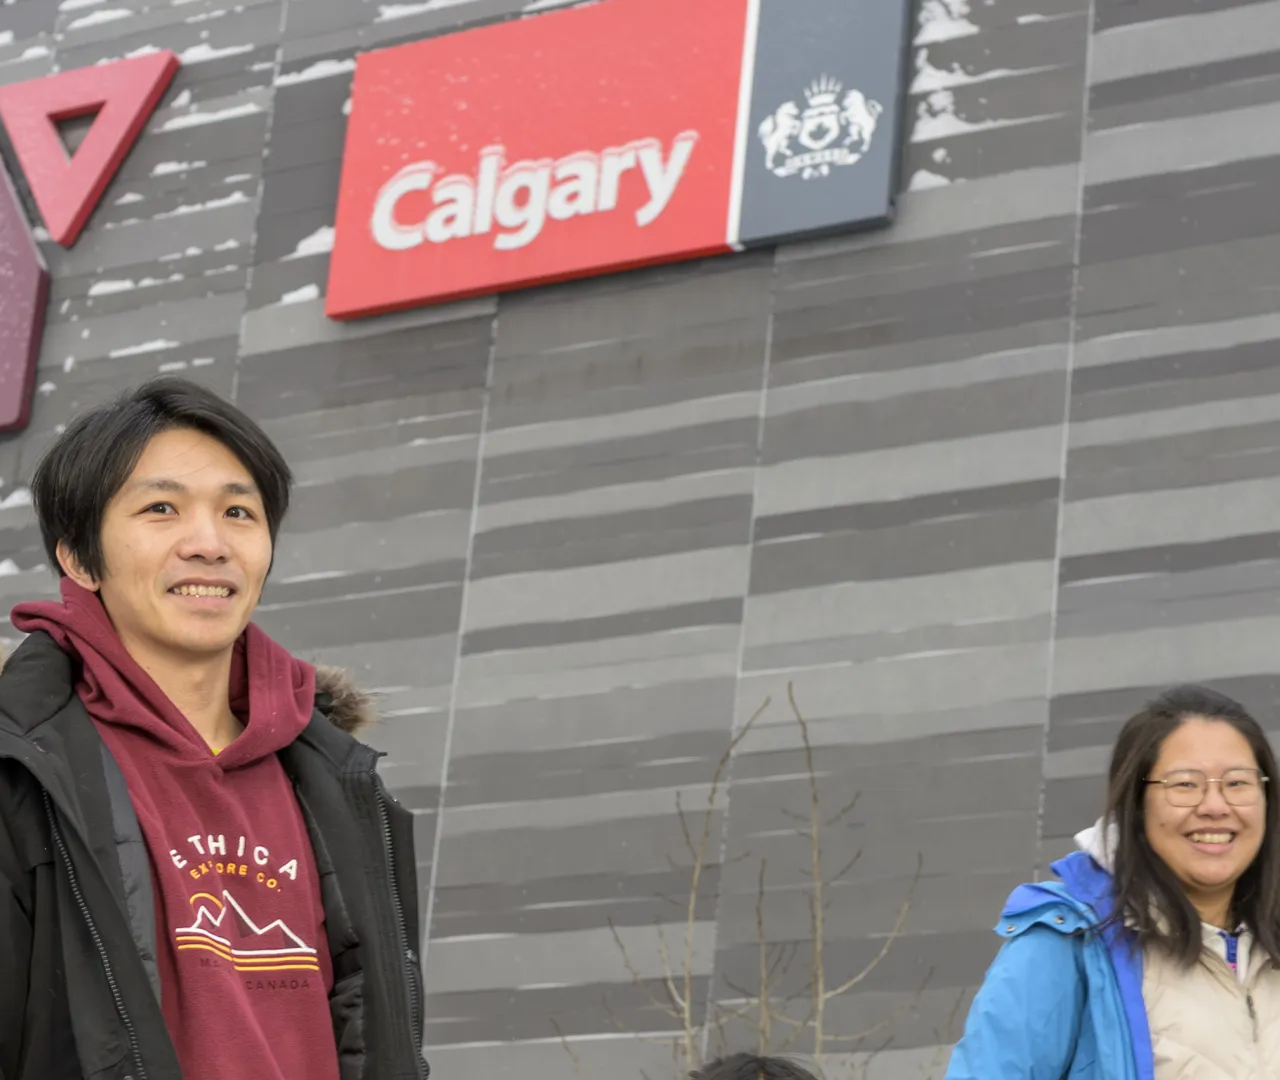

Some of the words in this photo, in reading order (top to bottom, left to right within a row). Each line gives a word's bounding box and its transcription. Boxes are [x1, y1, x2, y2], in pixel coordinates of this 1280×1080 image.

[369, 130, 700, 251] Calgary
[169, 834, 298, 881] ETHICA
[244, 979, 311, 991] CANADA
